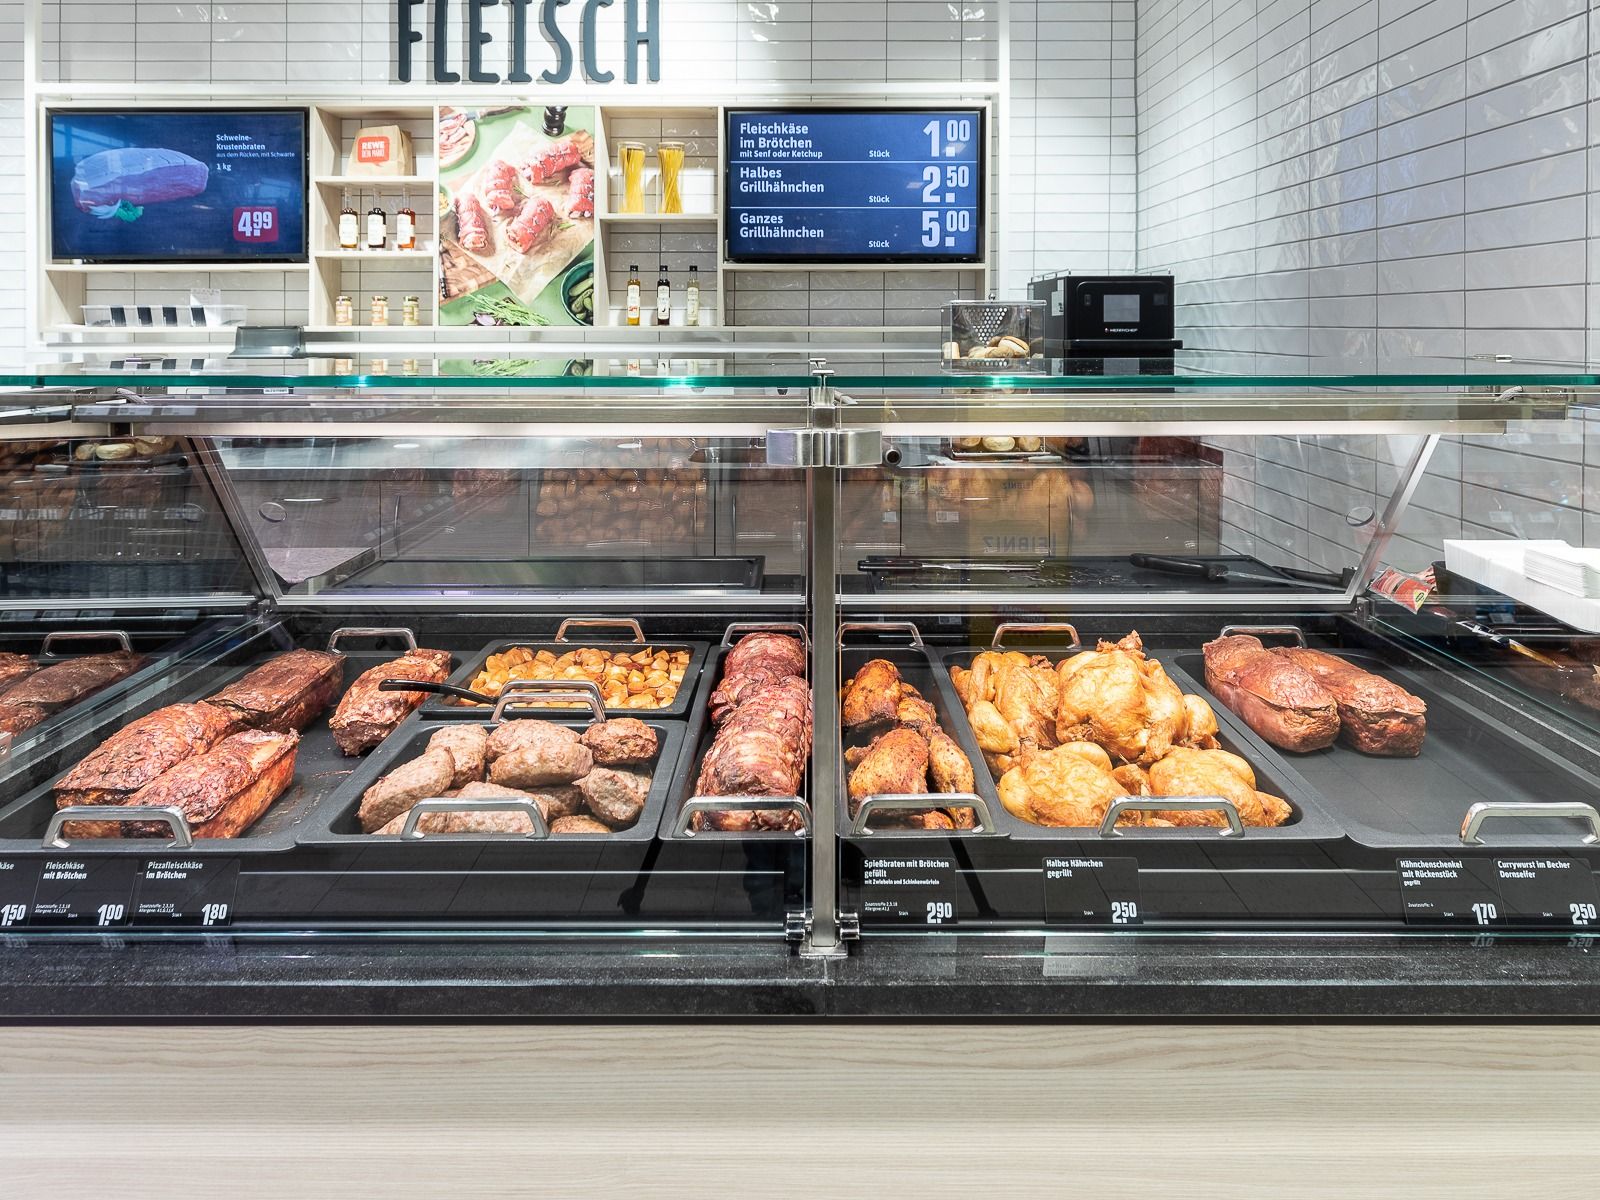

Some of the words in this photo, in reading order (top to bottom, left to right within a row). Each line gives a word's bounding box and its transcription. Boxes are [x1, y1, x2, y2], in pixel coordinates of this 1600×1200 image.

[398, 0, 660, 84] FLEISCH
[740, 123, 808, 134] Fleischkäse
[361, 141, 385, 150] REWE
[740, 137, 755, 148] im
[758, 136, 812, 149] Brötchen
[740, 150, 753, 158] mit
[754, 150, 770, 158] Senf
[772, 150, 790, 158] oder
[792, 150, 823, 159] Ketchup
[869, 150, 890, 158] Stück
[222, 163, 232, 171] kg
[740, 167, 782, 178] Halbes
[740, 181, 824, 193] Grillhähnchen
[869, 195, 890, 203] Stück
[740, 212, 784, 225] Ganzes
[237, 211, 273, 237] 4.99
[740, 226, 824, 238] Grillhähnchen
[869, 240, 890, 248] Stück
[45, 862, 85, 870] Fleischkäse
[148, 861, 203, 870] Pizzafleischkäse
[864, 860, 905, 868] Spießbraten
[906, 860, 918, 868] mit
[919, 860, 949, 868] Brötchen
[1046, 860, 1069, 868] Halbes
[1070, 860, 1104, 868] Hähnchen
[1400, 860, 1463, 869] Hähnchenschenkel
[1498, 861, 1536, 870] Currywurst
[1536, 861, 1545, 869] im
[1546, 861, 1571, 869] Becher
[43, 871, 55, 880] mit
[56, 871, 87, 880] Brötchen
[146, 871, 155, 879] im
[156, 871, 187, 879] Brötchen
[864, 869, 887, 879] gefüllt
[1047, 869, 1072, 879] gegrillt
[1402, 870, 1414, 878] mit
[1415, 870, 1458, 878] Rückenstück
[1499, 870, 1536, 878] Dornseifer
